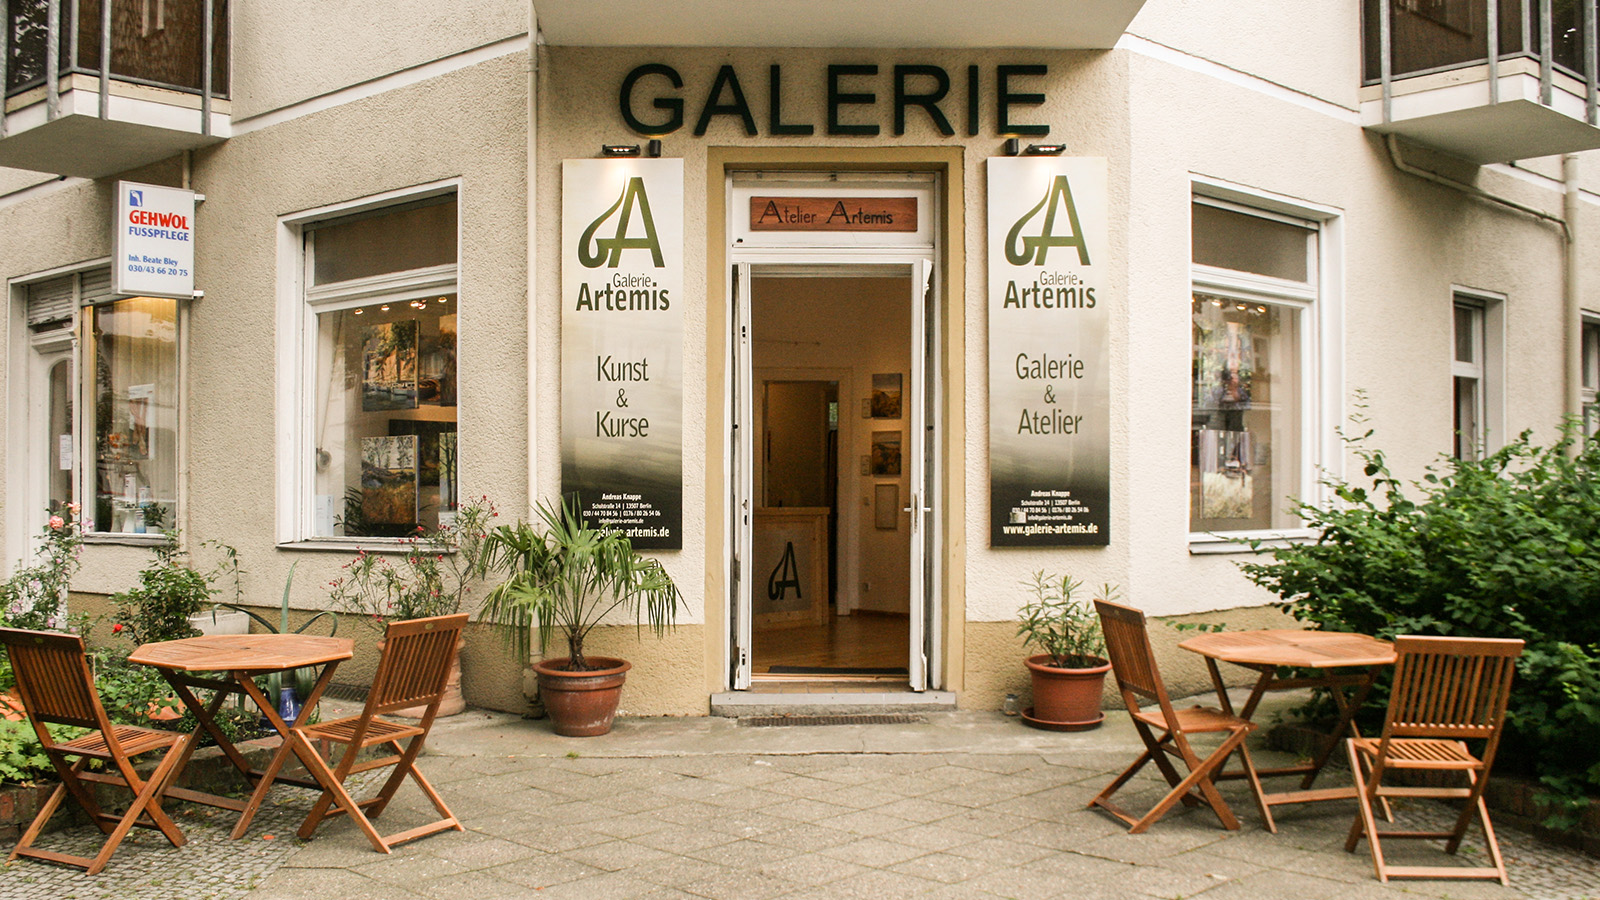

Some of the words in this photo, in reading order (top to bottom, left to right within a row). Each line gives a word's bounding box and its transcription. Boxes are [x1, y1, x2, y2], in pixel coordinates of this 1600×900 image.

[619, 63, 1050, 137] GALERIE
[129, 210, 189, 230] GEHWOL
[758, 200, 817, 224] Atelier
[826, 200, 893, 225] Artemis
[129, 226, 189, 241] FUSSPFLEGE
[128, 254, 141, 263] Inh.
[143, 255, 162, 264] Beate
[163, 257, 178, 267] Bley
[128, 264, 155, 274] 030/43
[157, 266, 166, 275] 66
[168, 267, 177, 276] 20
[179, 268, 188, 277] 75
[613, 273, 651, 287] Galerie
[1040, 271, 1078, 285] Galerie
[576, 281, 670, 311] Artemis
[1003, 280, 1096, 309] Artemis
[597, 355, 649, 382] Kunst
[1016, 353, 1084, 379] Galerie
[616, 388, 628, 408] &
[1044, 384, 1056, 404] &
[596, 411, 649, 438] Kurse
[1018, 408, 1083, 434] Atelier
[623, 493, 642, 501] Knappe
[1051, 490, 1071, 498] Knappe
[1003, 523, 1098, 536] www.galerie-artemis.de
